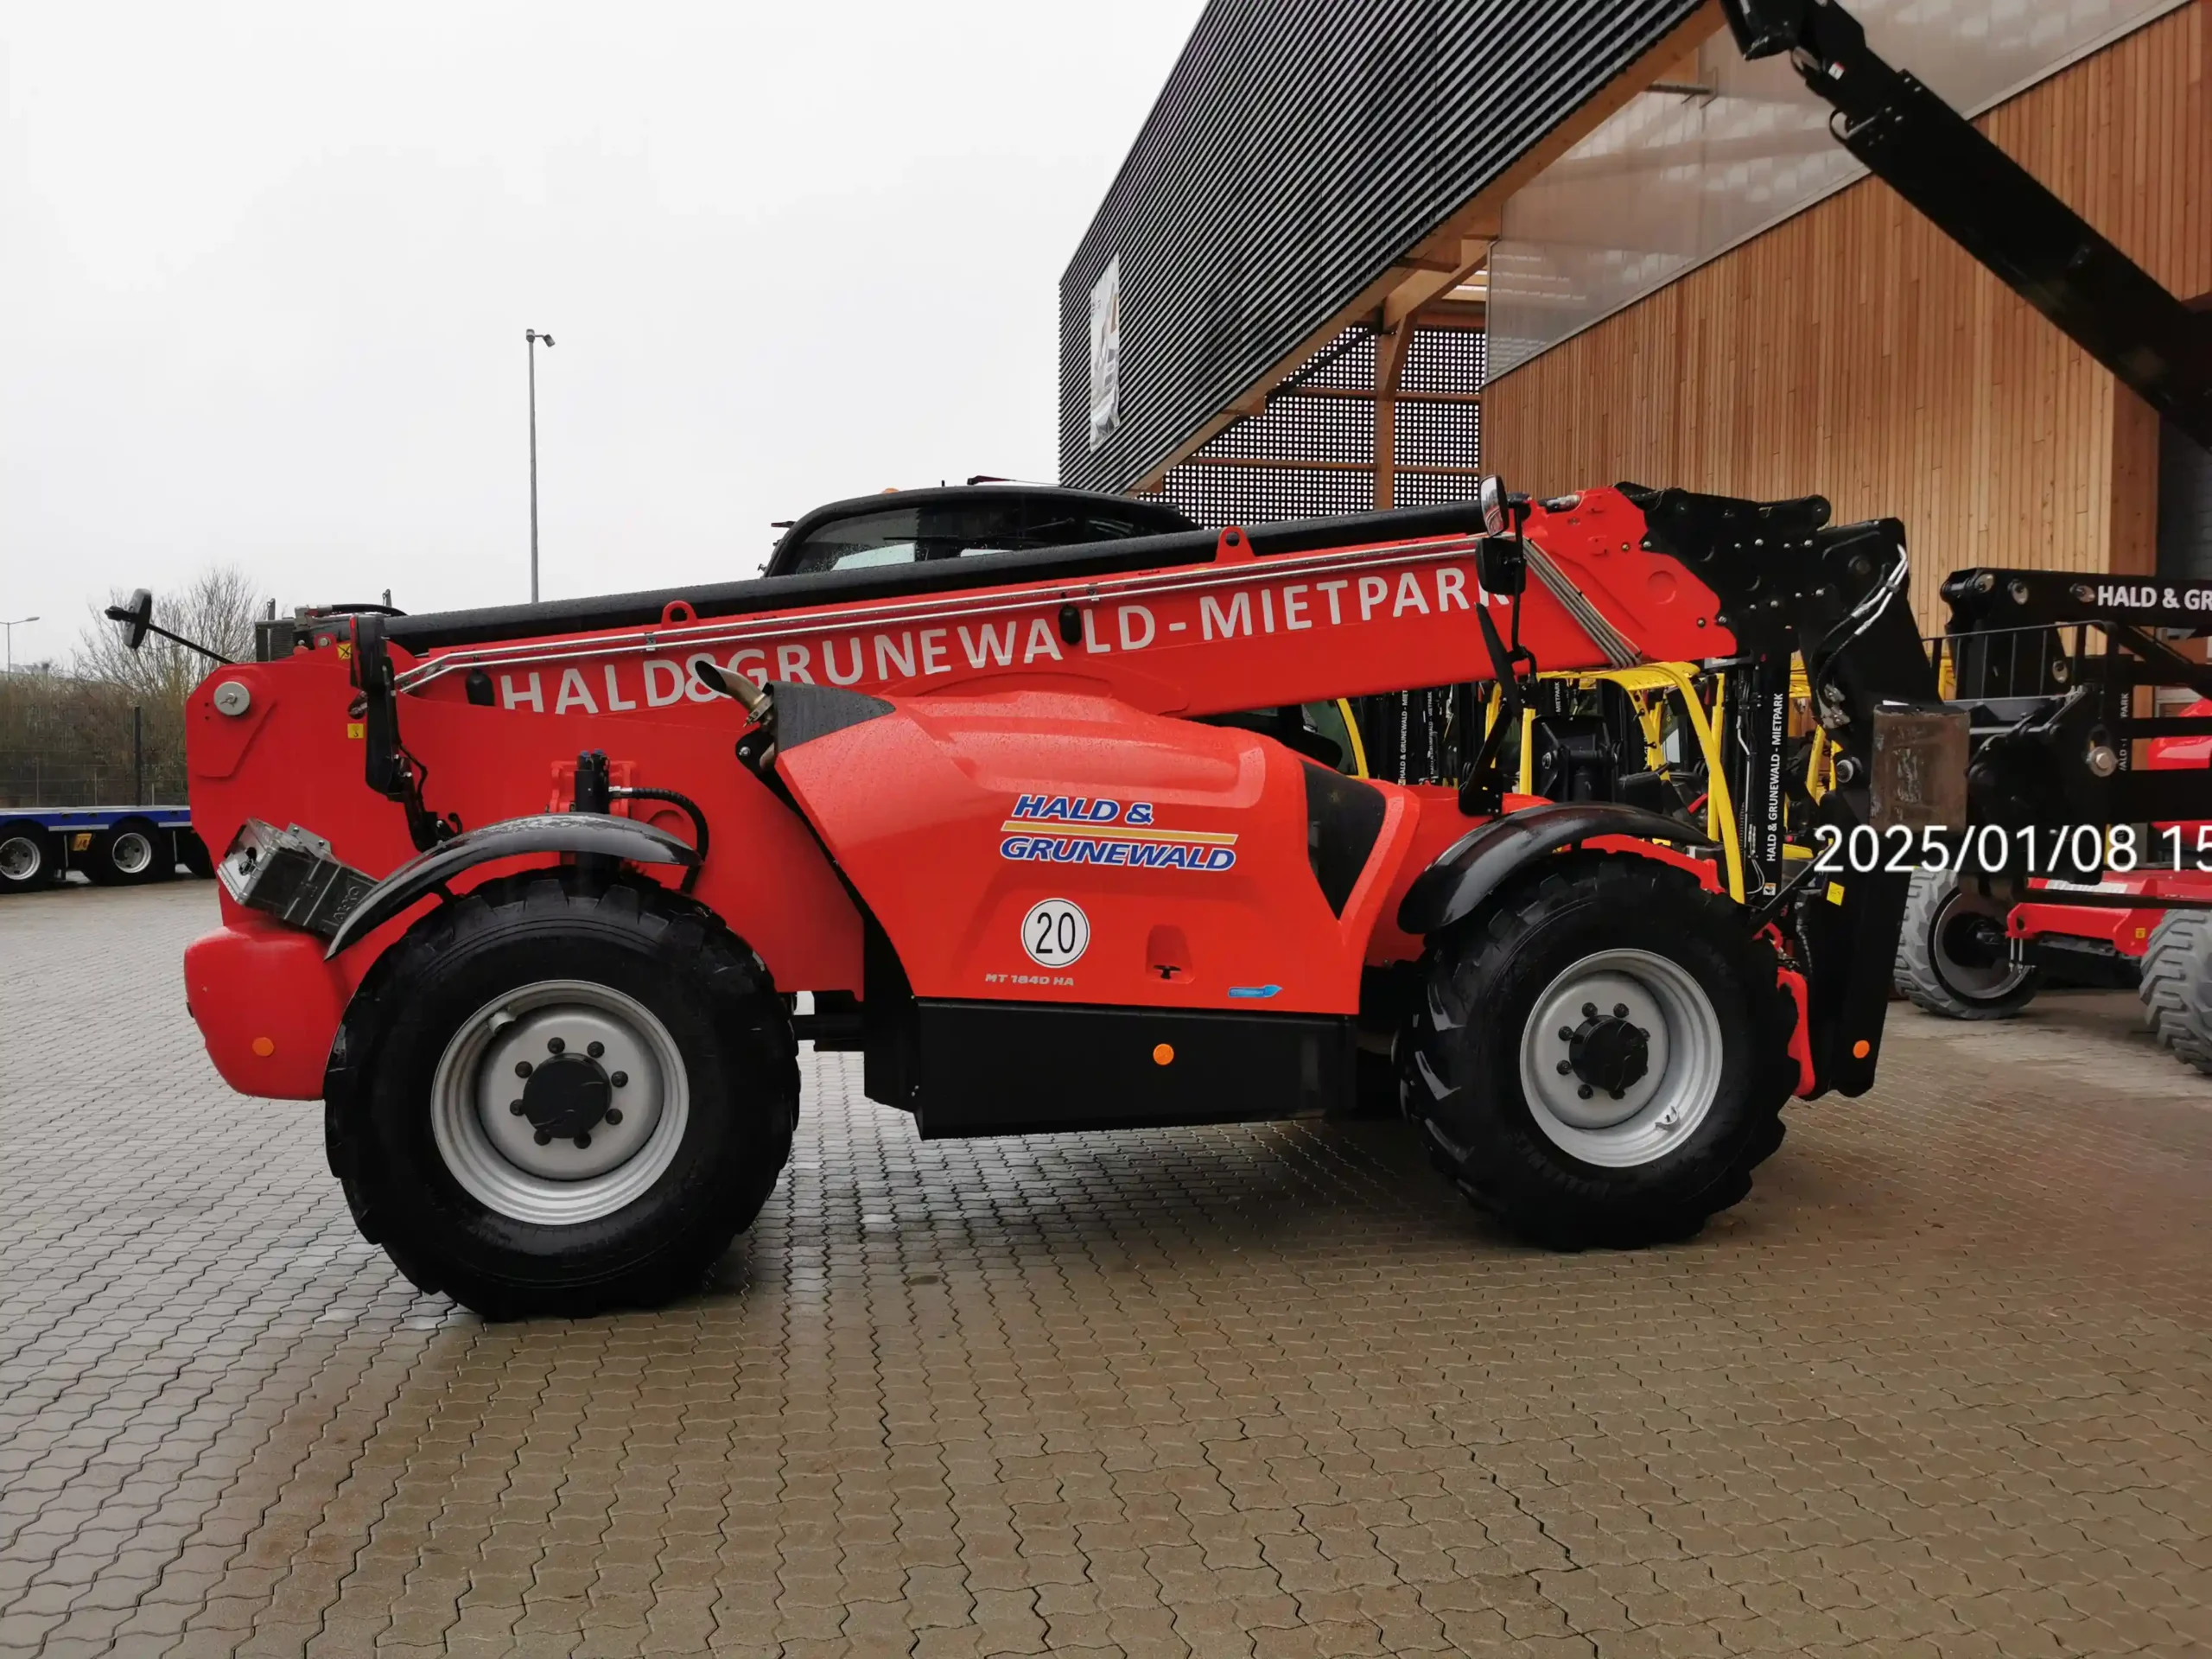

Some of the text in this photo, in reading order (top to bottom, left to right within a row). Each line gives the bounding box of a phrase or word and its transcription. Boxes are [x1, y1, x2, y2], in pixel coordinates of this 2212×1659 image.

[2097, 585, 2158, 607] HALD
[2162, 588, 2181, 609] &
[1400, 711, 1408, 753] GRUNEWALD
[1771, 693, 1783, 746] MIETPARK
[1768, 753, 1782, 821] GRUNEWALD
[1011, 794, 1154, 825] HALD &
[1767, 823, 1777, 833] &
[1000, 836, 1236, 872] GRUNEWALD
[1766, 834, 1777, 862] HALD
[1035, 912, 1076, 954] 20
[985, 973, 1074, 986] MT 1840 HA
